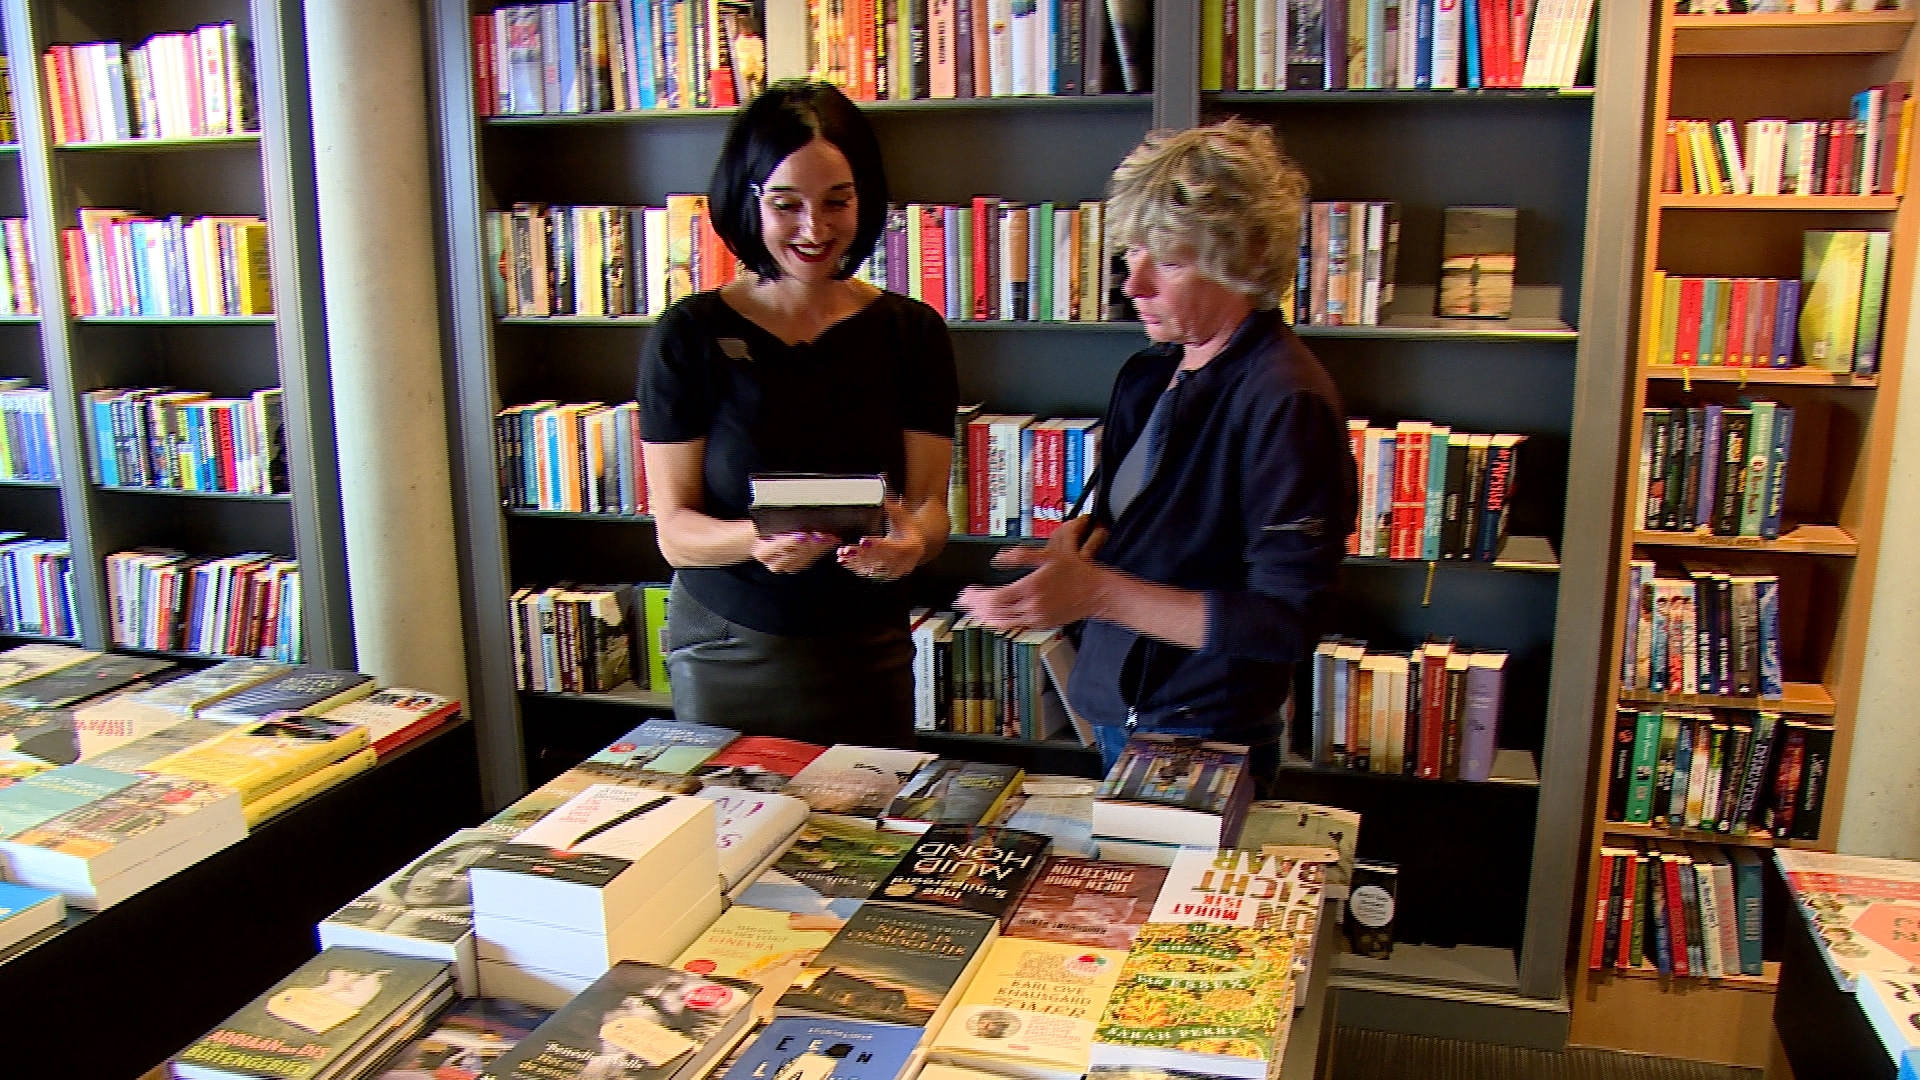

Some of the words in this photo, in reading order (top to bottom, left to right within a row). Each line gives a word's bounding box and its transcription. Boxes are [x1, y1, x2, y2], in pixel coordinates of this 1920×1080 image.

[917, 843, 1032, 868] HOND
[914, 857, 1015, 880] MUID
[1051, 863, 1135, 882] PAKISTAN
[1212, 849, 1325, 885] BAAR
[890, 876, 1008, 898] Schilperoord
[1045, 874, 1082, 887] NAAR
[1086, 880, 1129, 892] TREIN
[1191, 870, 1322, 906] ZICHT
[922, 887, 962, 899] Inge
[1204, 895, 1243, 908] ISIK
[1170, 903, 1240, 920] MURAT
[1011, 979, 1047, 991] KARL
[1053, 985, 1088, 996] OVE
[1106, 1027, 1171, 1040] SARAH
[1179, 1026, 1241, 1037] PERRY
[206, 1029, 286, 1052] ADRIAAN
[298, 1044, 331, 1059] DIS
[182, 1041, 312, 1077] BUITENGEBIED
